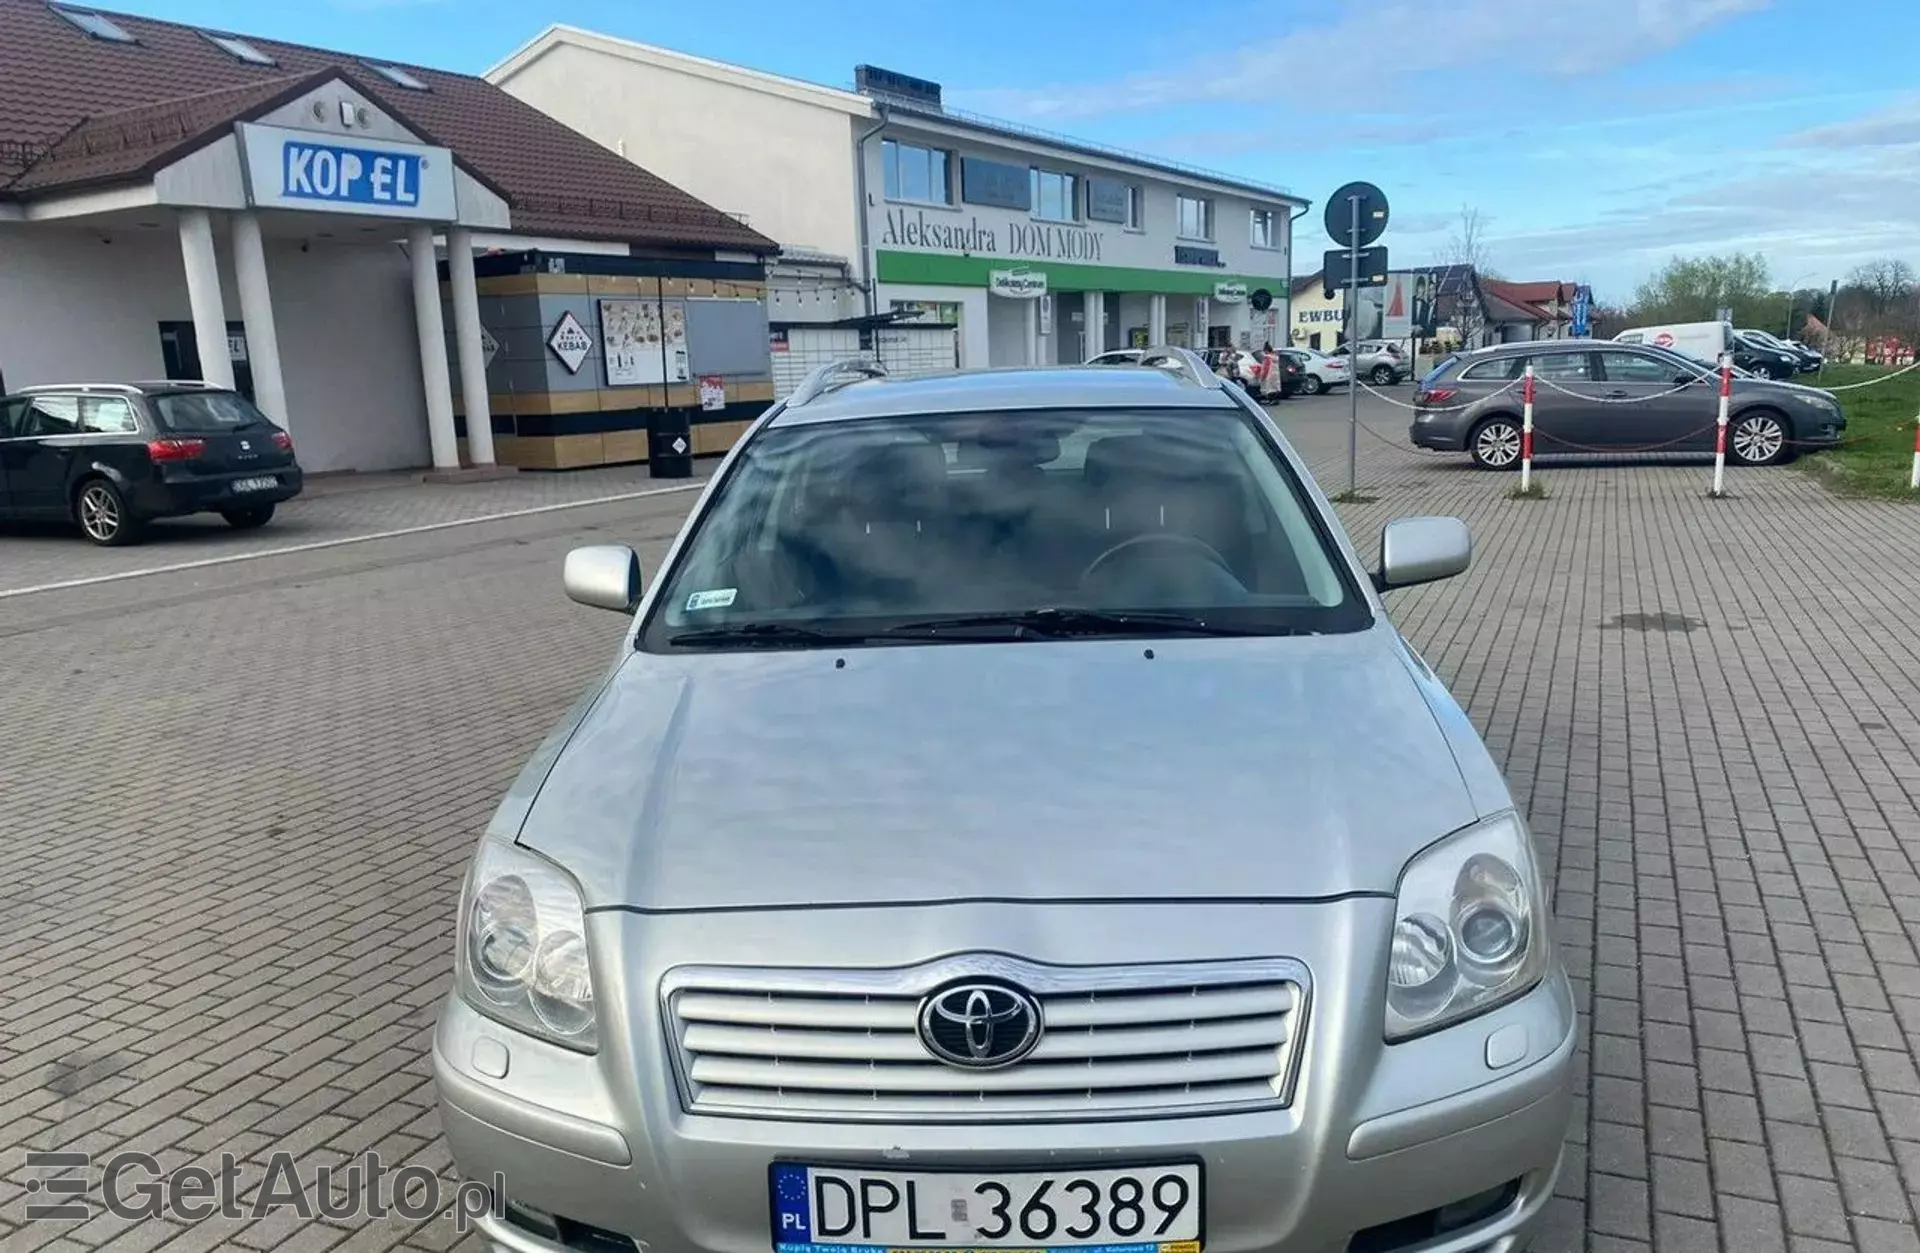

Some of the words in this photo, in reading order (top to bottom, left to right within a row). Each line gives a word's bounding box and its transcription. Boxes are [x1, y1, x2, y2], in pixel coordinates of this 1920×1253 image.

[882, 208, 997, 252] Aleksandra
[1009, 222, 1051, 257] DOM
[1056, 228, 1104, 262] MODY
[782, 1213, 806, 1230] PL
[814, 1175, 947, 1240] DPL
[974, 1173, 1189, 1240] 36389
